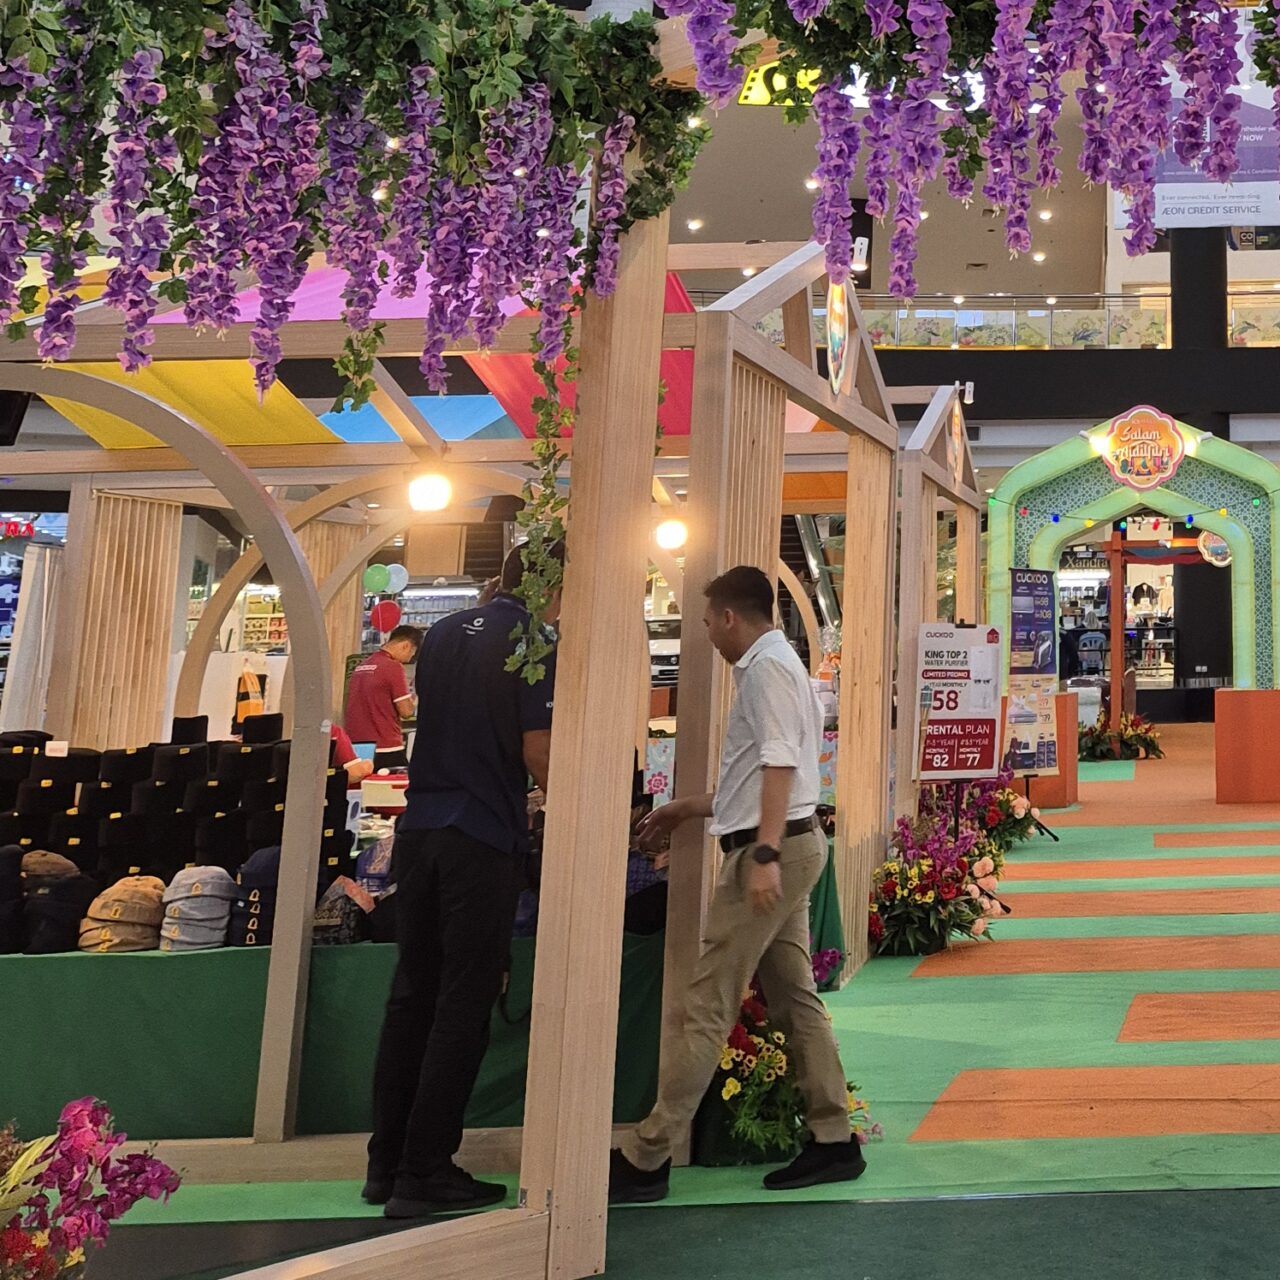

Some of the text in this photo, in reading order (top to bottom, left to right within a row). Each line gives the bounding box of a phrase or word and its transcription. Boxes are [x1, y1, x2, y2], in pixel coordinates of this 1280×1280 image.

[1187, 206, 1220, 215] CREDIT
[1223, 205, 1262, 214] SERVICE
[1120, 426, 1161, 441] Salam
[1016, 573, 1048, 584] CUCKOO
[924, 651, 968, 659] KING TOP 2
[926, 724, 990, 735] RENTAL PLAN
[932, 754, 949, 768] 82
[966, 753, 980, 766] 77
